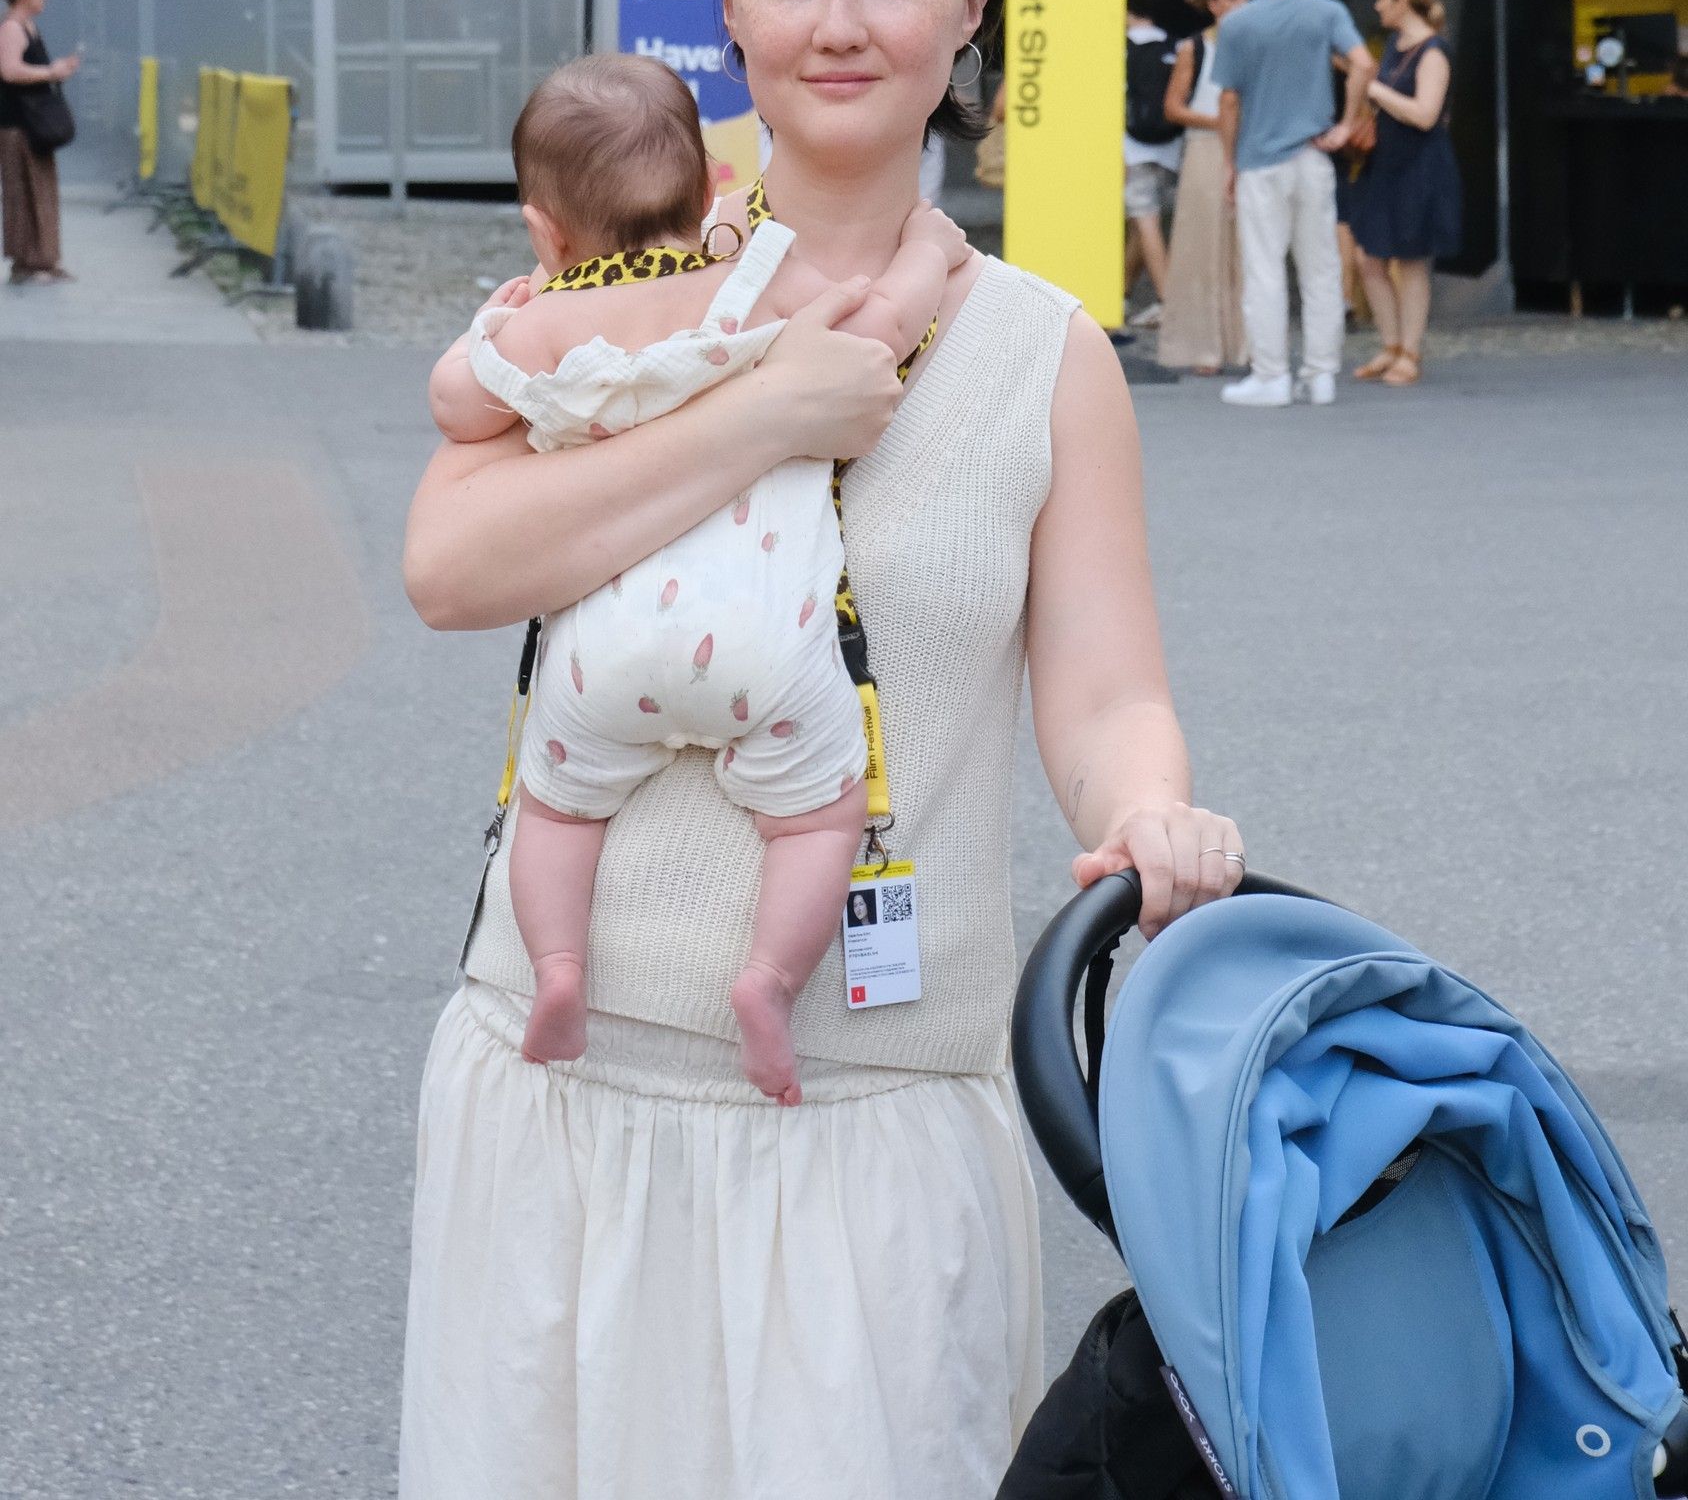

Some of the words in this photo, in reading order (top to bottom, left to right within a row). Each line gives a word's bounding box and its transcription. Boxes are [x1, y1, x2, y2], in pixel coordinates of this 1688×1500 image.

[634, 36, 722, 73] Have
[1014, 28, 1048, 130] Shop
[864, 705, 875, 752] Festival
[868, 754, 878, 780] Film
[1199, 1435, 1234, 1493] STOKKE
